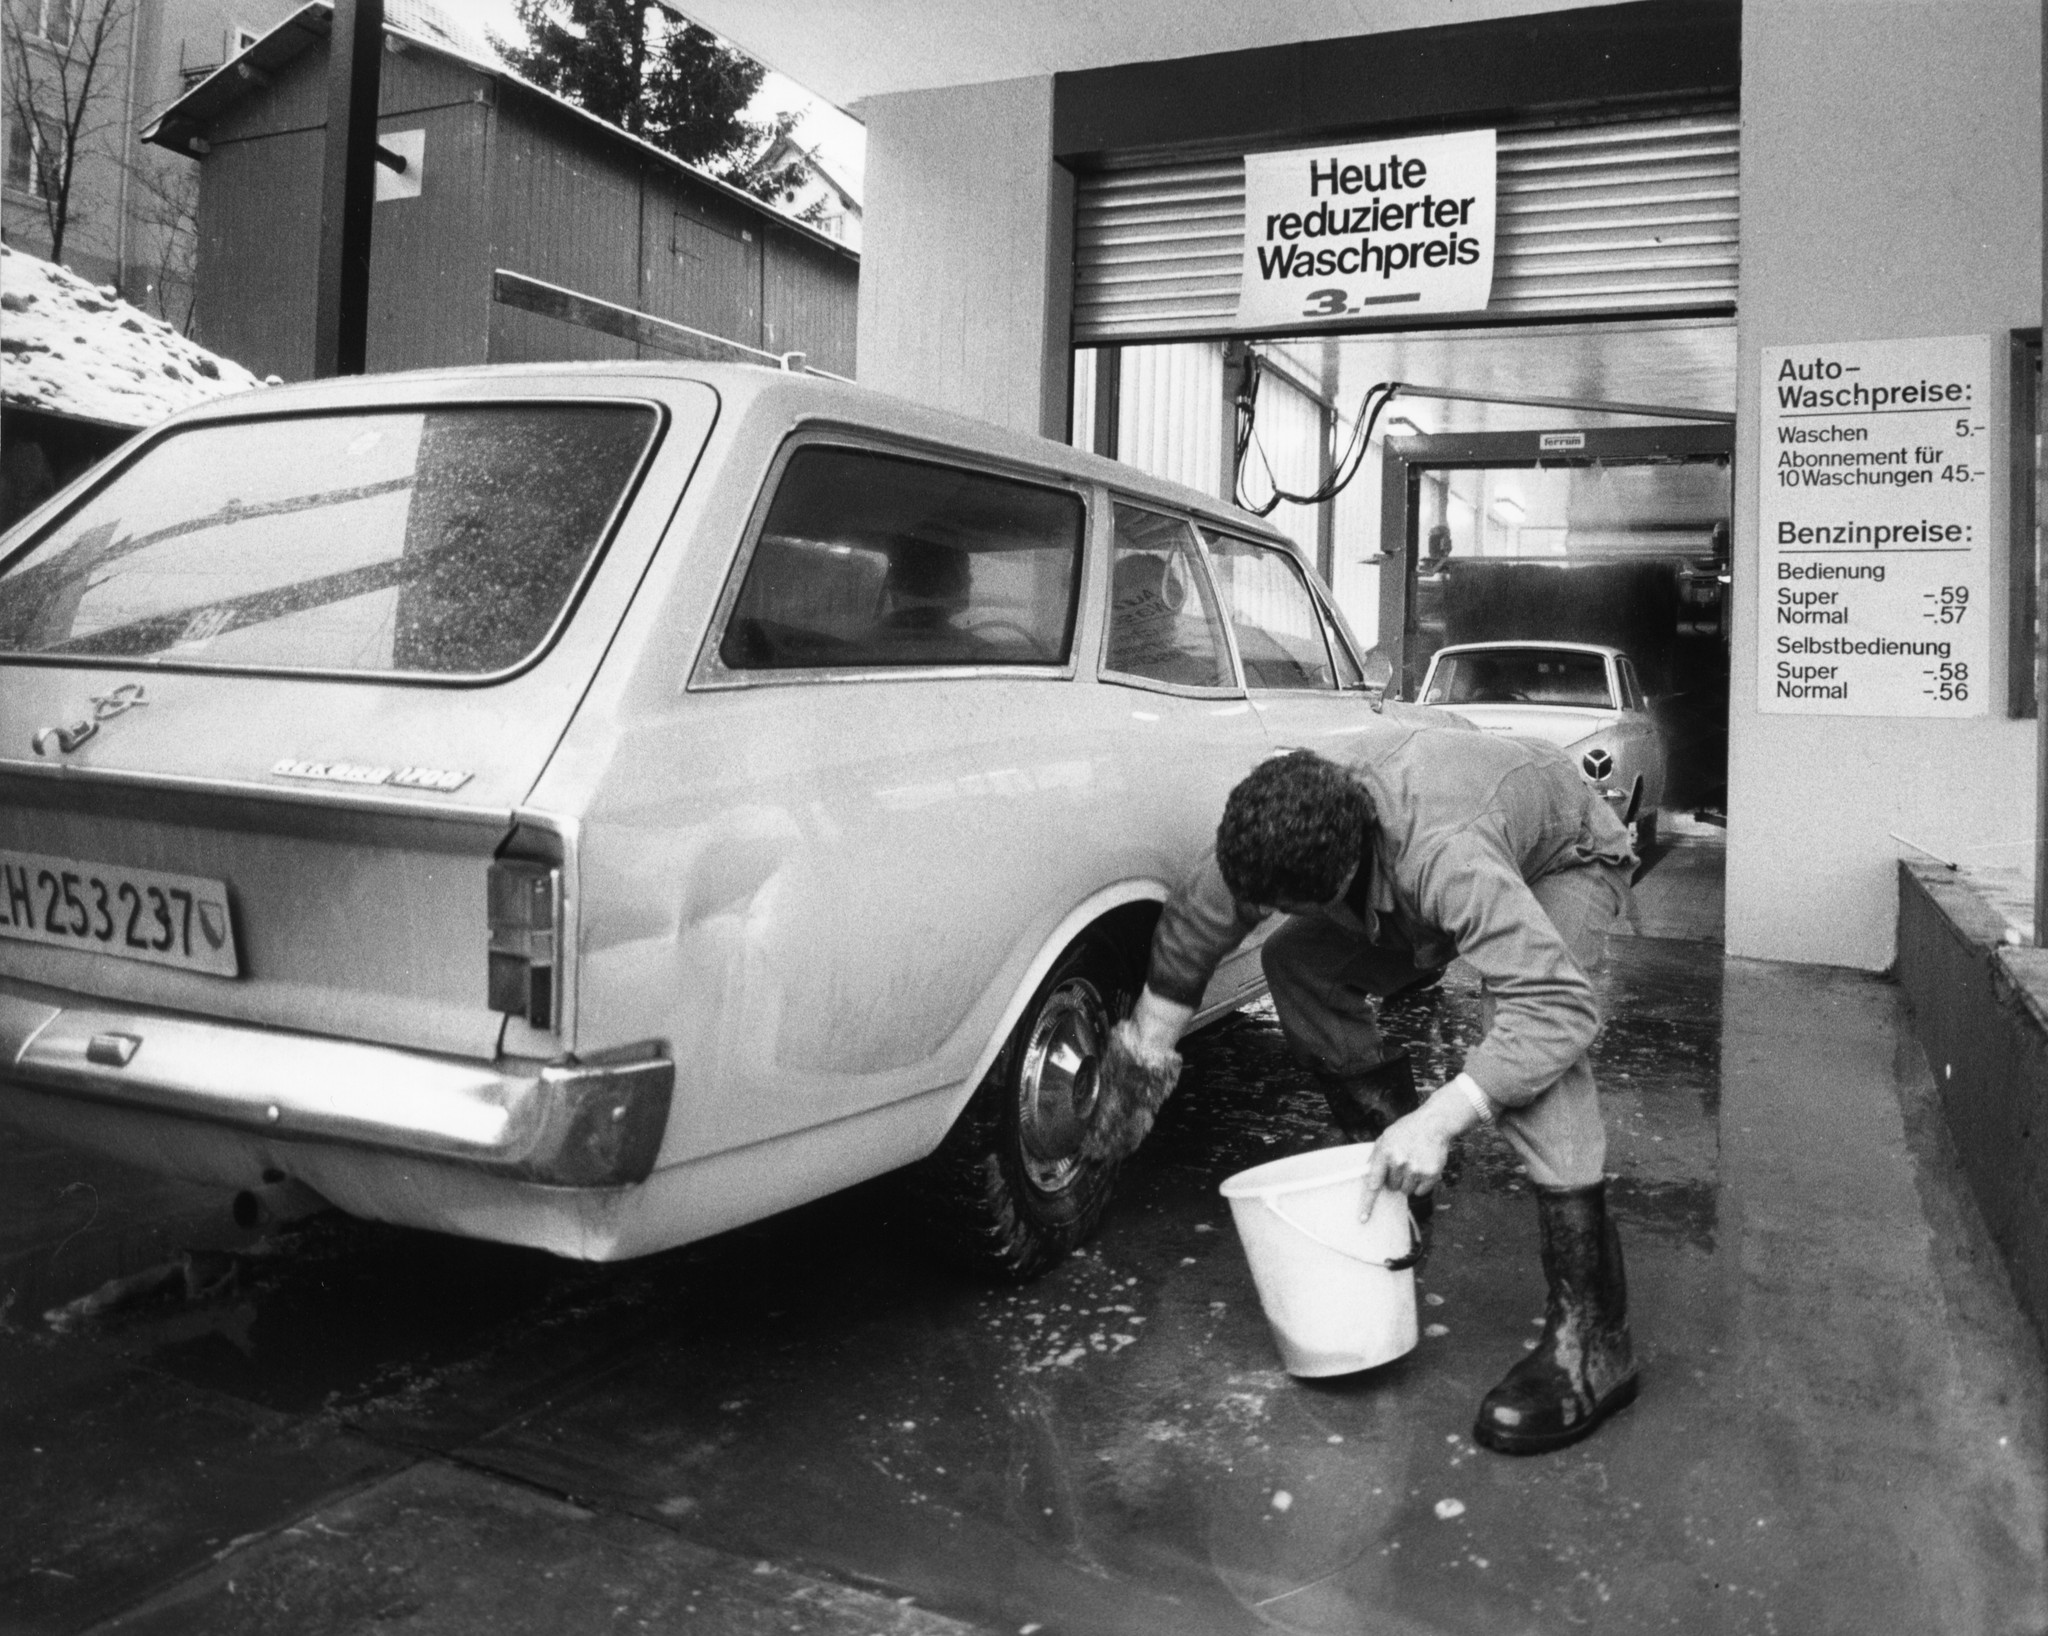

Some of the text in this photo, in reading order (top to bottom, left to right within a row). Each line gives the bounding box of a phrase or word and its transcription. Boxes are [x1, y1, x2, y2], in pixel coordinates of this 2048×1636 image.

[1310, 154, 1427, 197] Heute
[1266, 194, 1476, 241] reduzierter
[1257, 231, 1480, 280] Waschpreis
[1777, 380, 1972, 411] Waschpreise:
[1777, 424, 1868, 443] Waschen
[1777, 446, 1944, 468] Abonnement für
[1801, 467, 1933, 487] Waschungen
[1778, 519, 1972, 549] Benzinpreise:
[1777, 562, 1886, 582] Bedienung
[1777, 587, 1839, 609] Super
[1777, 607, 1849, 624] Normal
[1777, 636, 1951, 659] Selbstbedienung
[1776, 661, 1838, 683] Super
[1776, 681, 1848, 699] Normal
